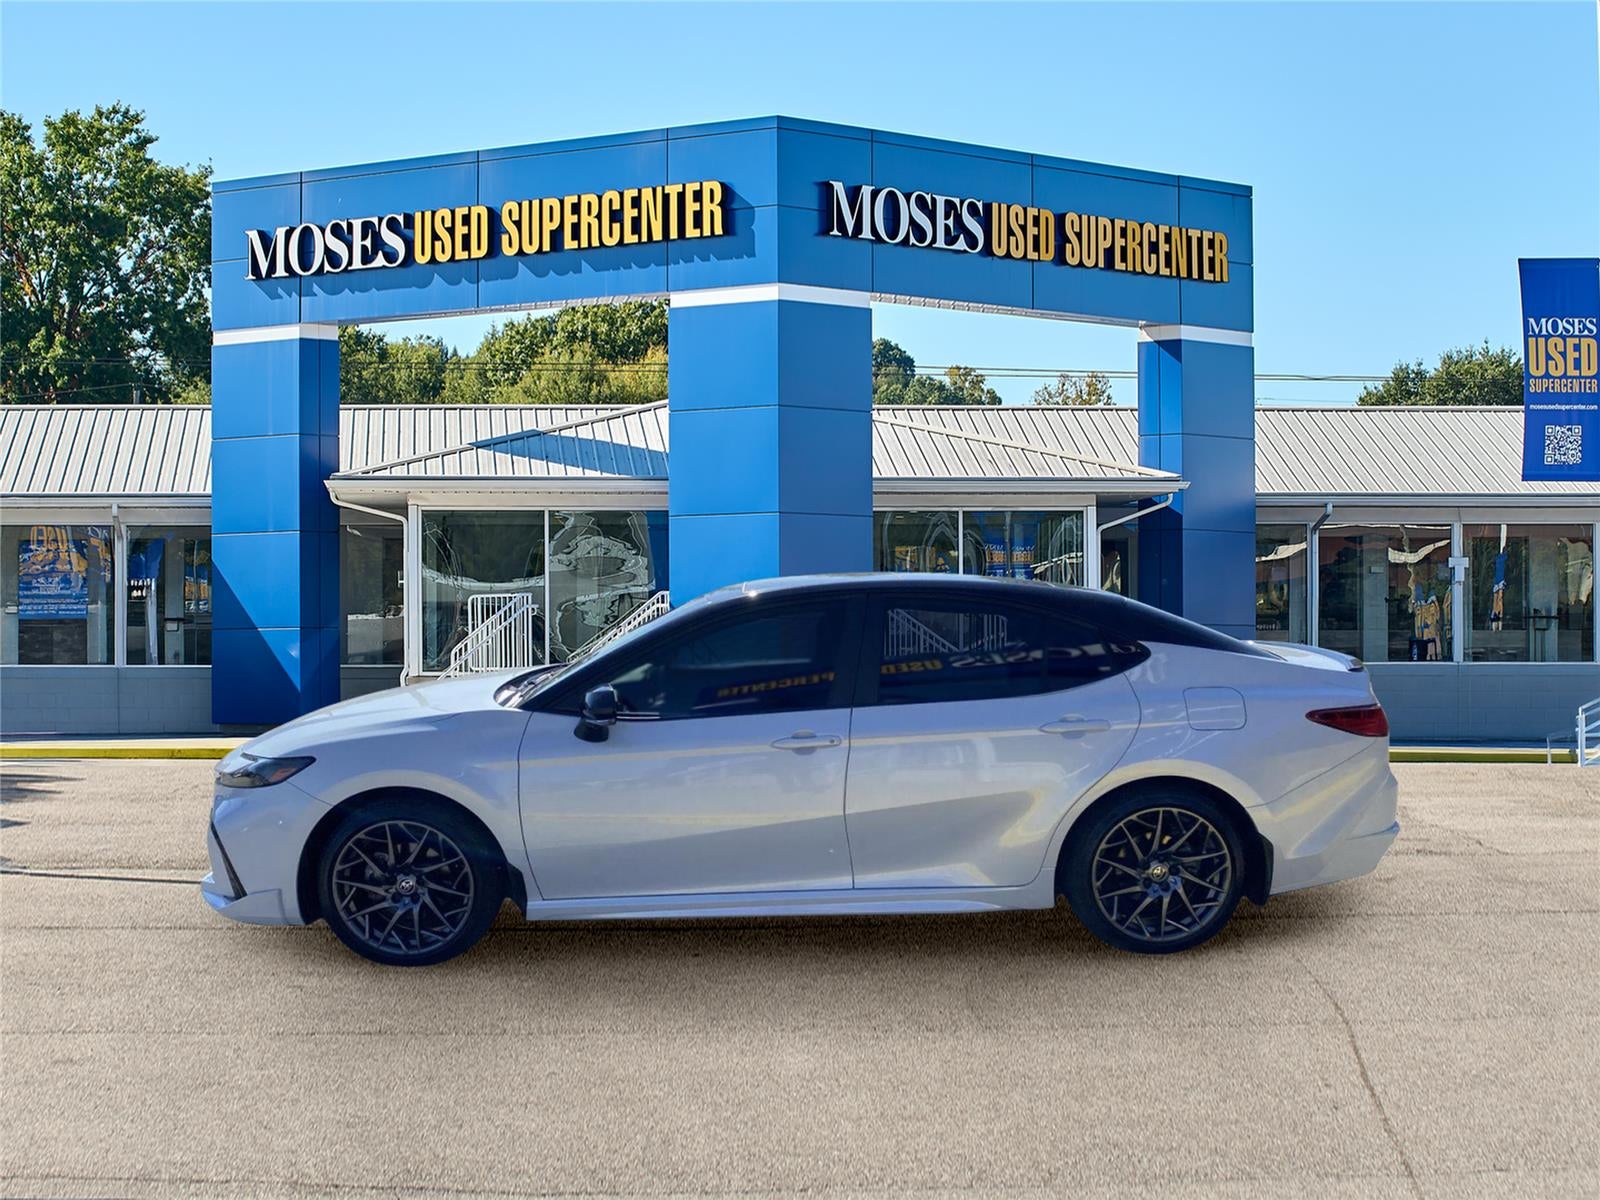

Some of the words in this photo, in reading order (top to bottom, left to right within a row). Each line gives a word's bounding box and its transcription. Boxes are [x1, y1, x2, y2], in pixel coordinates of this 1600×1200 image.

[244, 213, 406, 280] MOSES
[413, 205, 488, 264] USED
[501, 180, 724, 256] SUPERCENTER
[828, 180, 984, 253] MOSES
[991, 202, 1055, 261] USED
[1064, 212, 1230, 282] SUPERCENTER
[1527, 317, 1598, 336] MOSES
[1528, 337, 1598, 377] USED
[1529, 378, 1598, 393] SUPERCENTER
